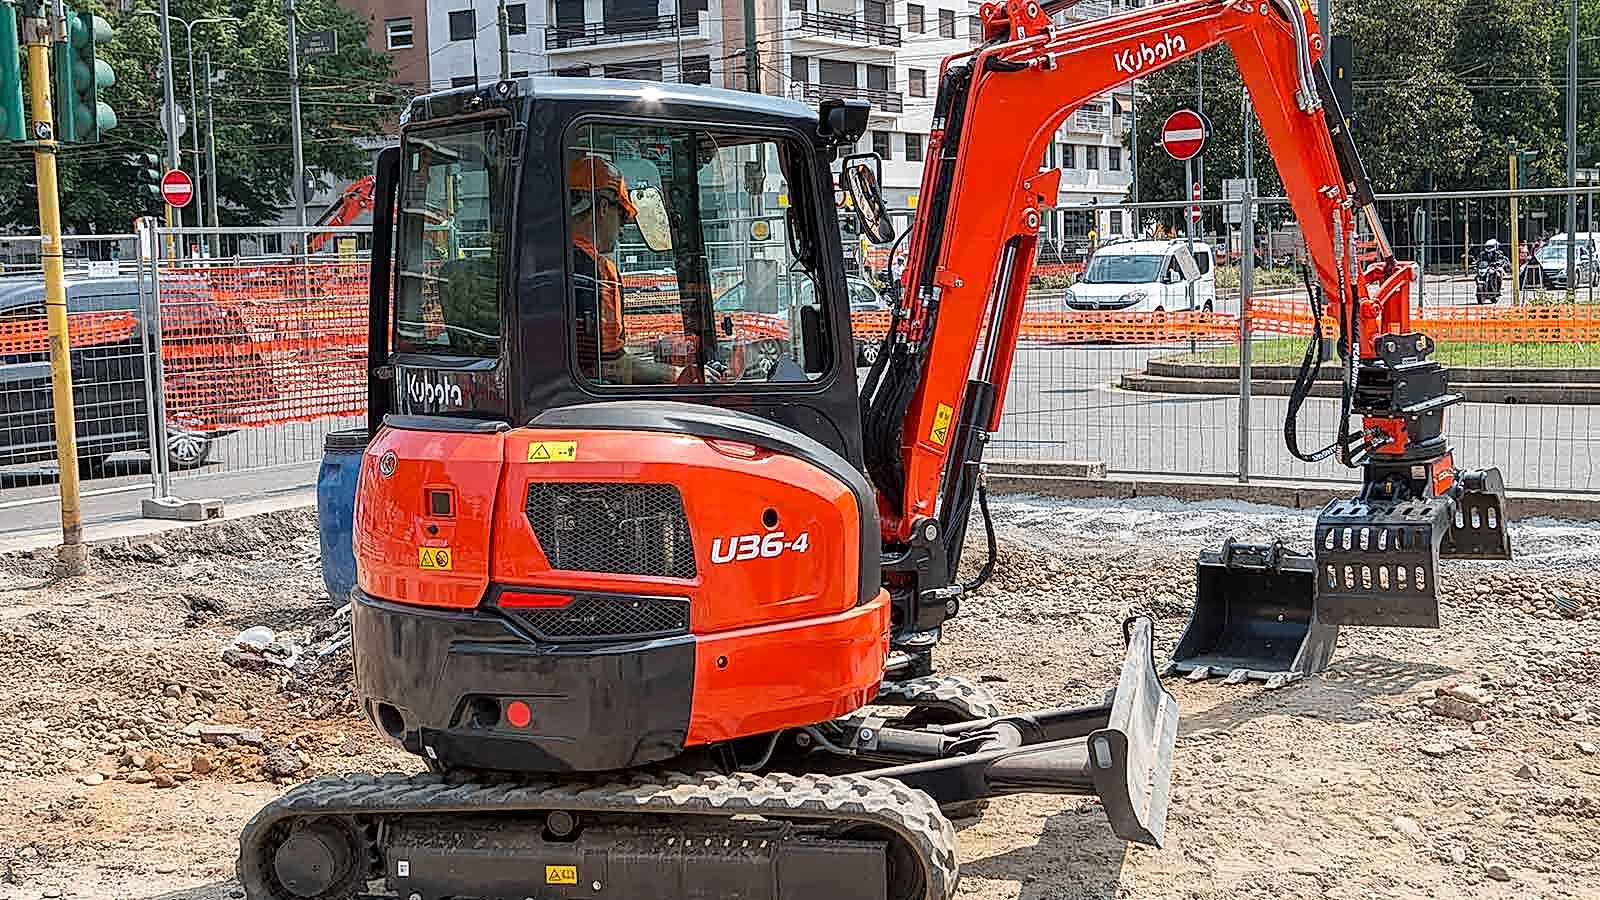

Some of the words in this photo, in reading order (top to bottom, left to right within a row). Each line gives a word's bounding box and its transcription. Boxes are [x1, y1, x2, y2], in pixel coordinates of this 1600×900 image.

[1114, 32, 1187, 74] Kubota
[406, 373, 463, 406] Kubota
[711, 531, 809, 564] U36-4
